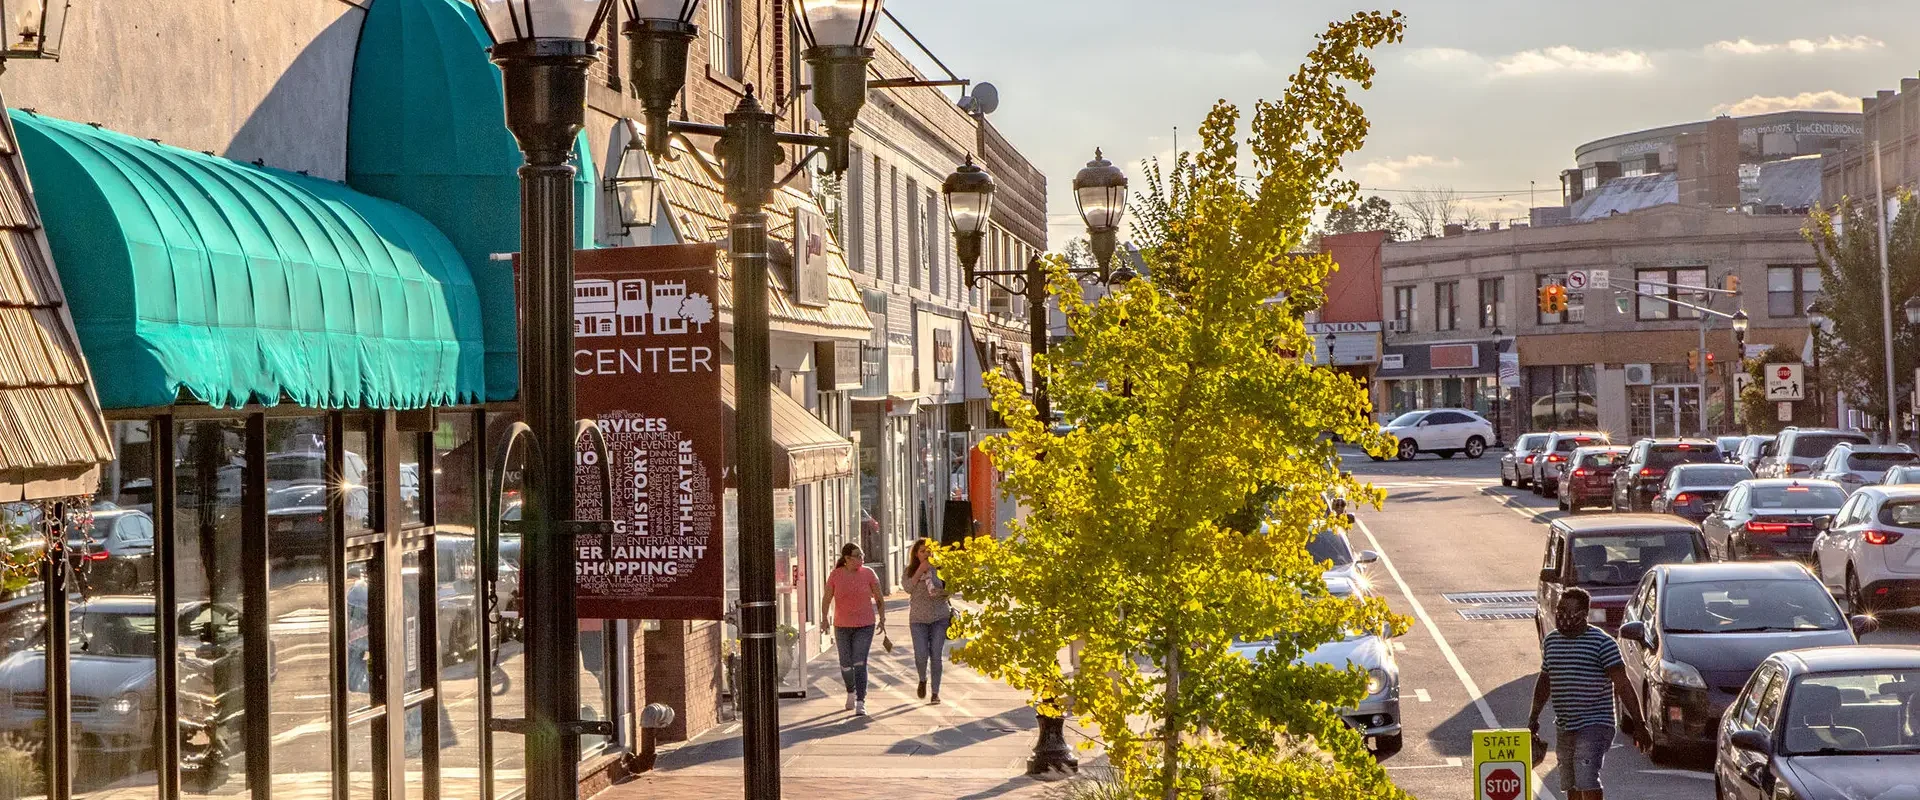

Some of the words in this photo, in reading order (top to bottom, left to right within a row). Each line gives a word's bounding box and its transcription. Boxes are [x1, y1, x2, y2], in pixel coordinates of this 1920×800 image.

[1312, 323, 1368, 332] UNION
[575, 347, 712, 375] CENTER
[598, 418, 667, 432] RVICES
[603, 431, 682, 441] ENTERTAINMENT
[641, 440, 678, 449] EVENTS
[624, 450, 634, 499] SERVICES
[655, 465, 680, 473] VISION
[633, 445, 649, 536] HISTORY
[679, 440, 693, 536] THEATER
[671, 474, 680, 536] ENTERTAINMENT
[626, 536, 708, 546] ENTERTAINMENT
[575, 546, 708, 559] ERAINMENT
[614, 575, 655, 584] THEATER
[1484, 736, 1520, 746] STATE
[1489, 749, 1515, 759] LAW
[1487, 779, 1519, 793] STOP
